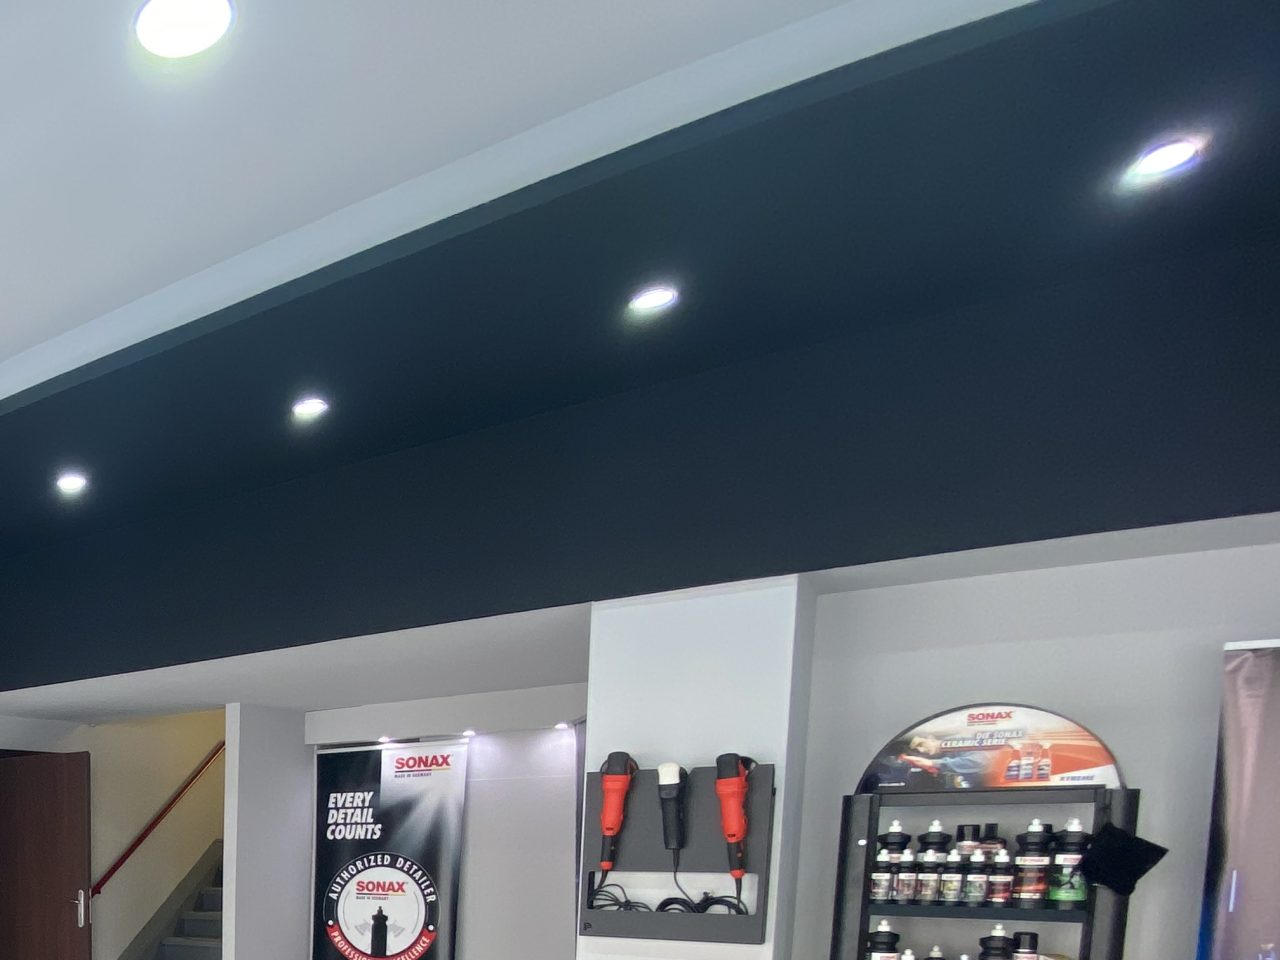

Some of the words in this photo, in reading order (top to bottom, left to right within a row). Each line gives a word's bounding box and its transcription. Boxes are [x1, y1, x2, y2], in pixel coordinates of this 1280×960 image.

[967, 711, 1013, 722] SONAX
[395, 754, 451, 770] SONAX
[328, 791, 375, 808] EVERY
[327, 808, 375, 825] DETAIL
[326, 823, 383, 841] COUNTS
[328, 854, 390, 901] AUTHORIZED
[396, 856, 437, 904] DETAILER
[356, 880, 406, 893] SONAX
